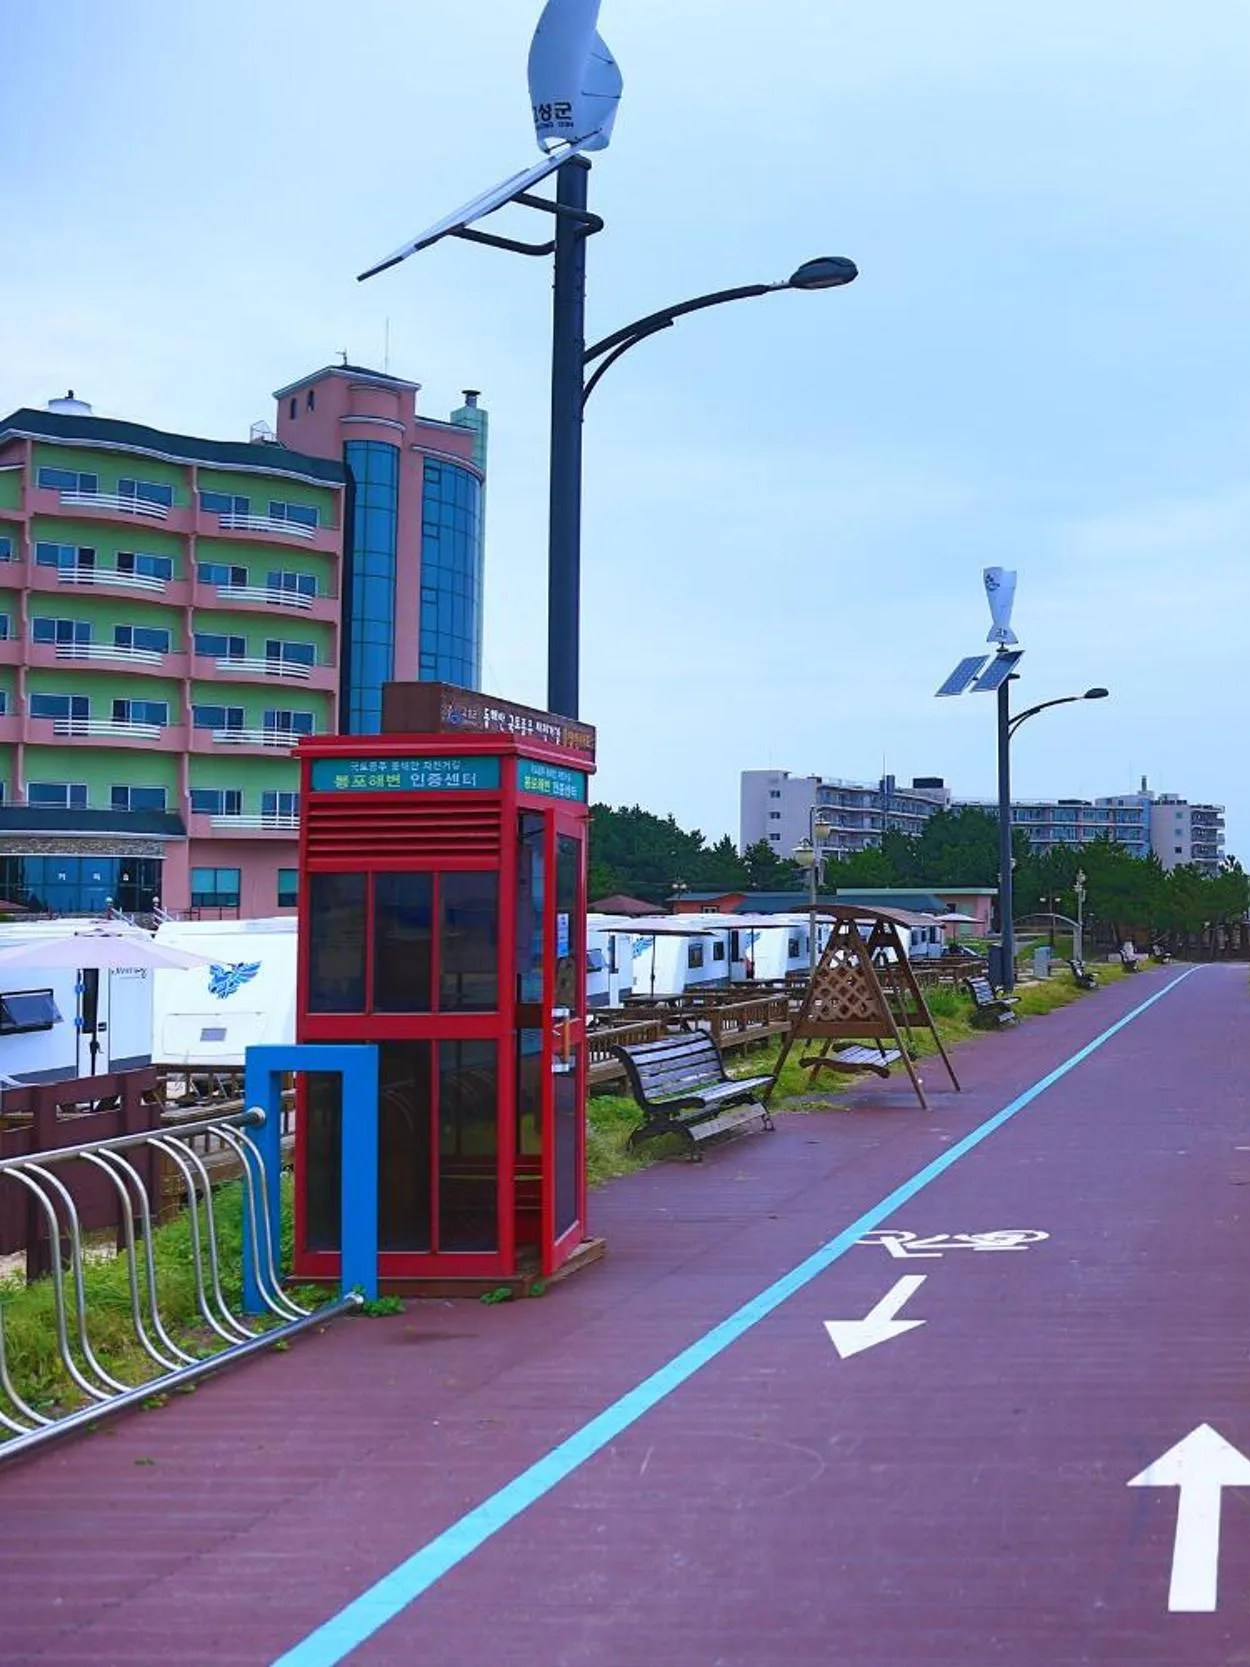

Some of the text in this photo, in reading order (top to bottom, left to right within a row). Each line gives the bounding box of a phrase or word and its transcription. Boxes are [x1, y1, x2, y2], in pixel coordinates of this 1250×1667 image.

[533, 102, 573, 122] 성군
[334, 772, 477, 789] 봉포해변 인증센터
